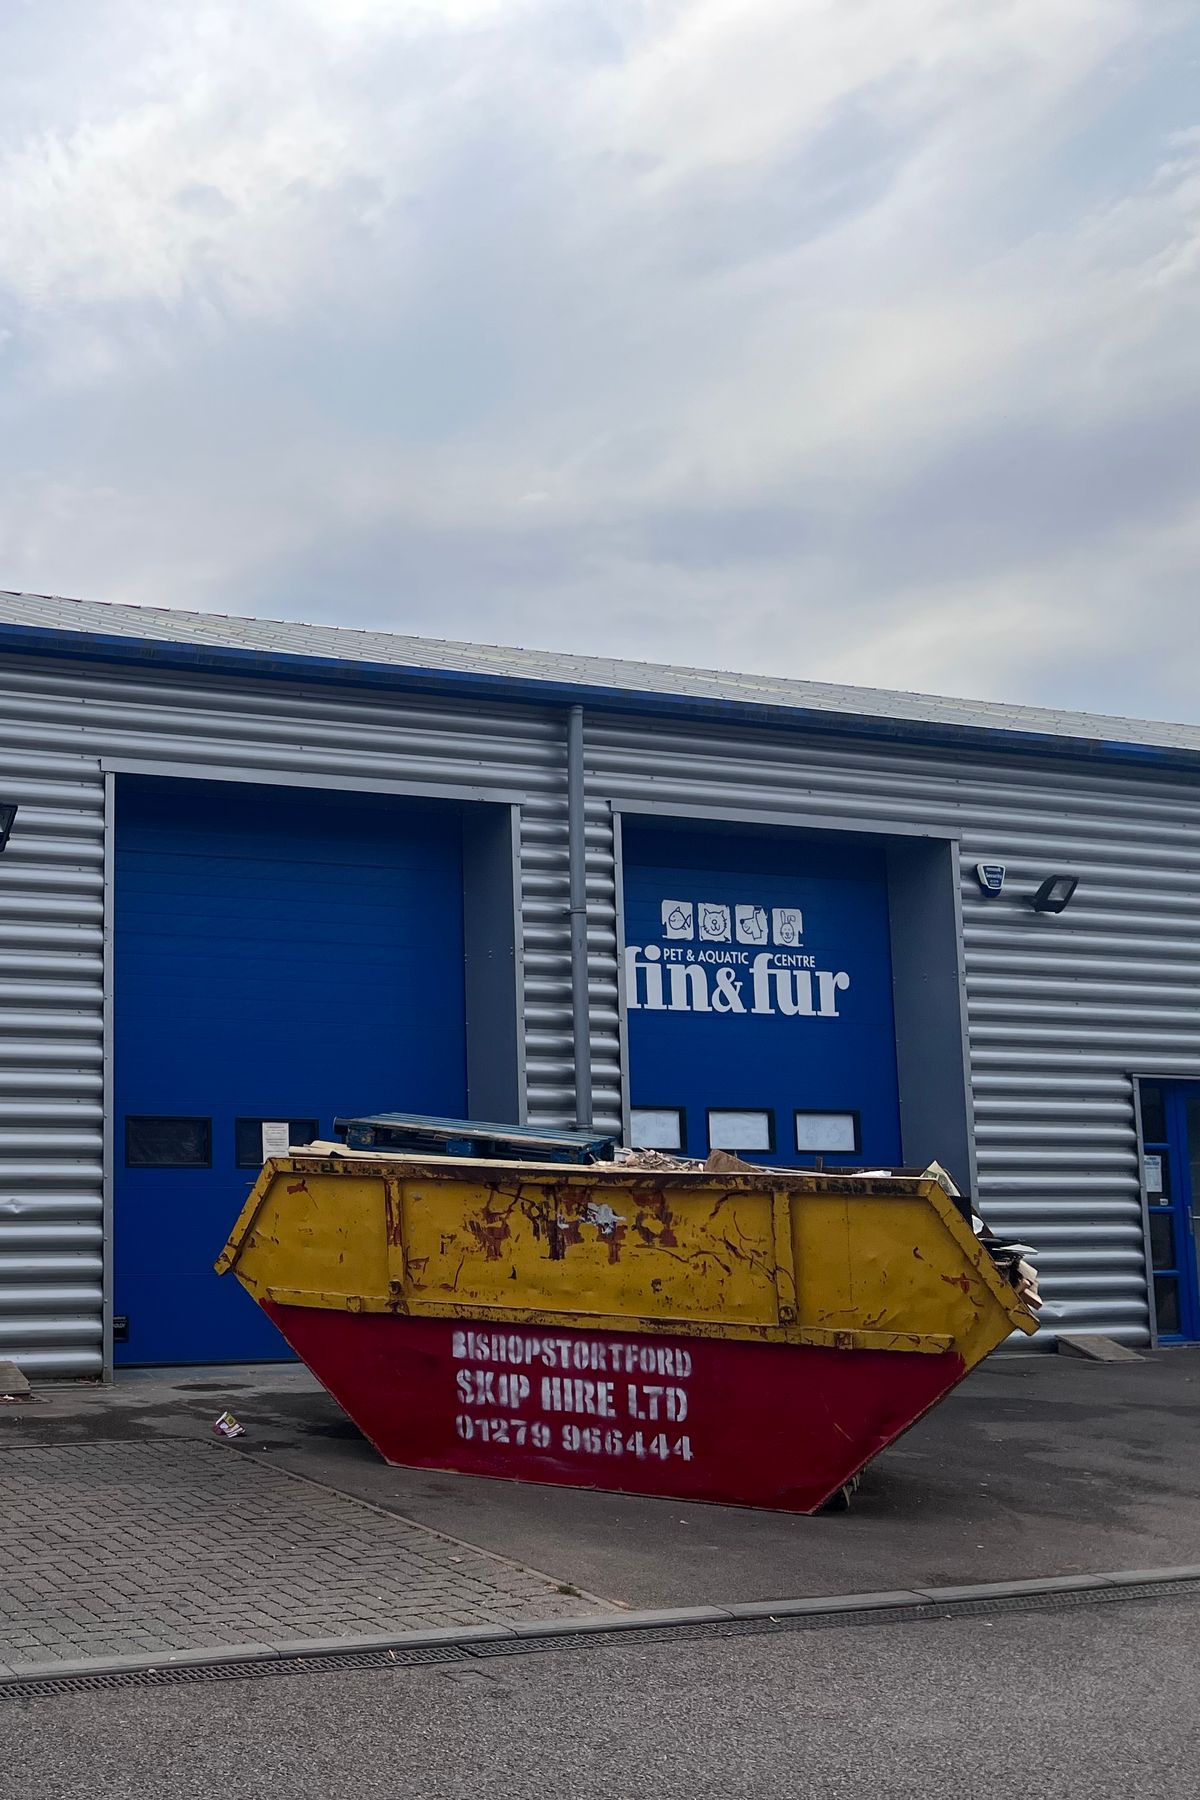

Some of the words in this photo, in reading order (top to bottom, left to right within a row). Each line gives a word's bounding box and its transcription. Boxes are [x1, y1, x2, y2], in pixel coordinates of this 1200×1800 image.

[663, 948, 683, 961] PET
[686, 949, 695, 962] &
[698, 951, 749, 965] AQUATIC
[774, 953, 815, 968] CENTRE
[452, 1330, 693, 1378] BISHOPSTORTFORD
[456, 1368, 530, 1409] SKIP
[541, 1376, 616, 1418] HIRE
[628, 1384, 688, 1422] LTD
[455, 1413, 551, 1448] 01279
[562, 1424, 694, 1461] 966444
